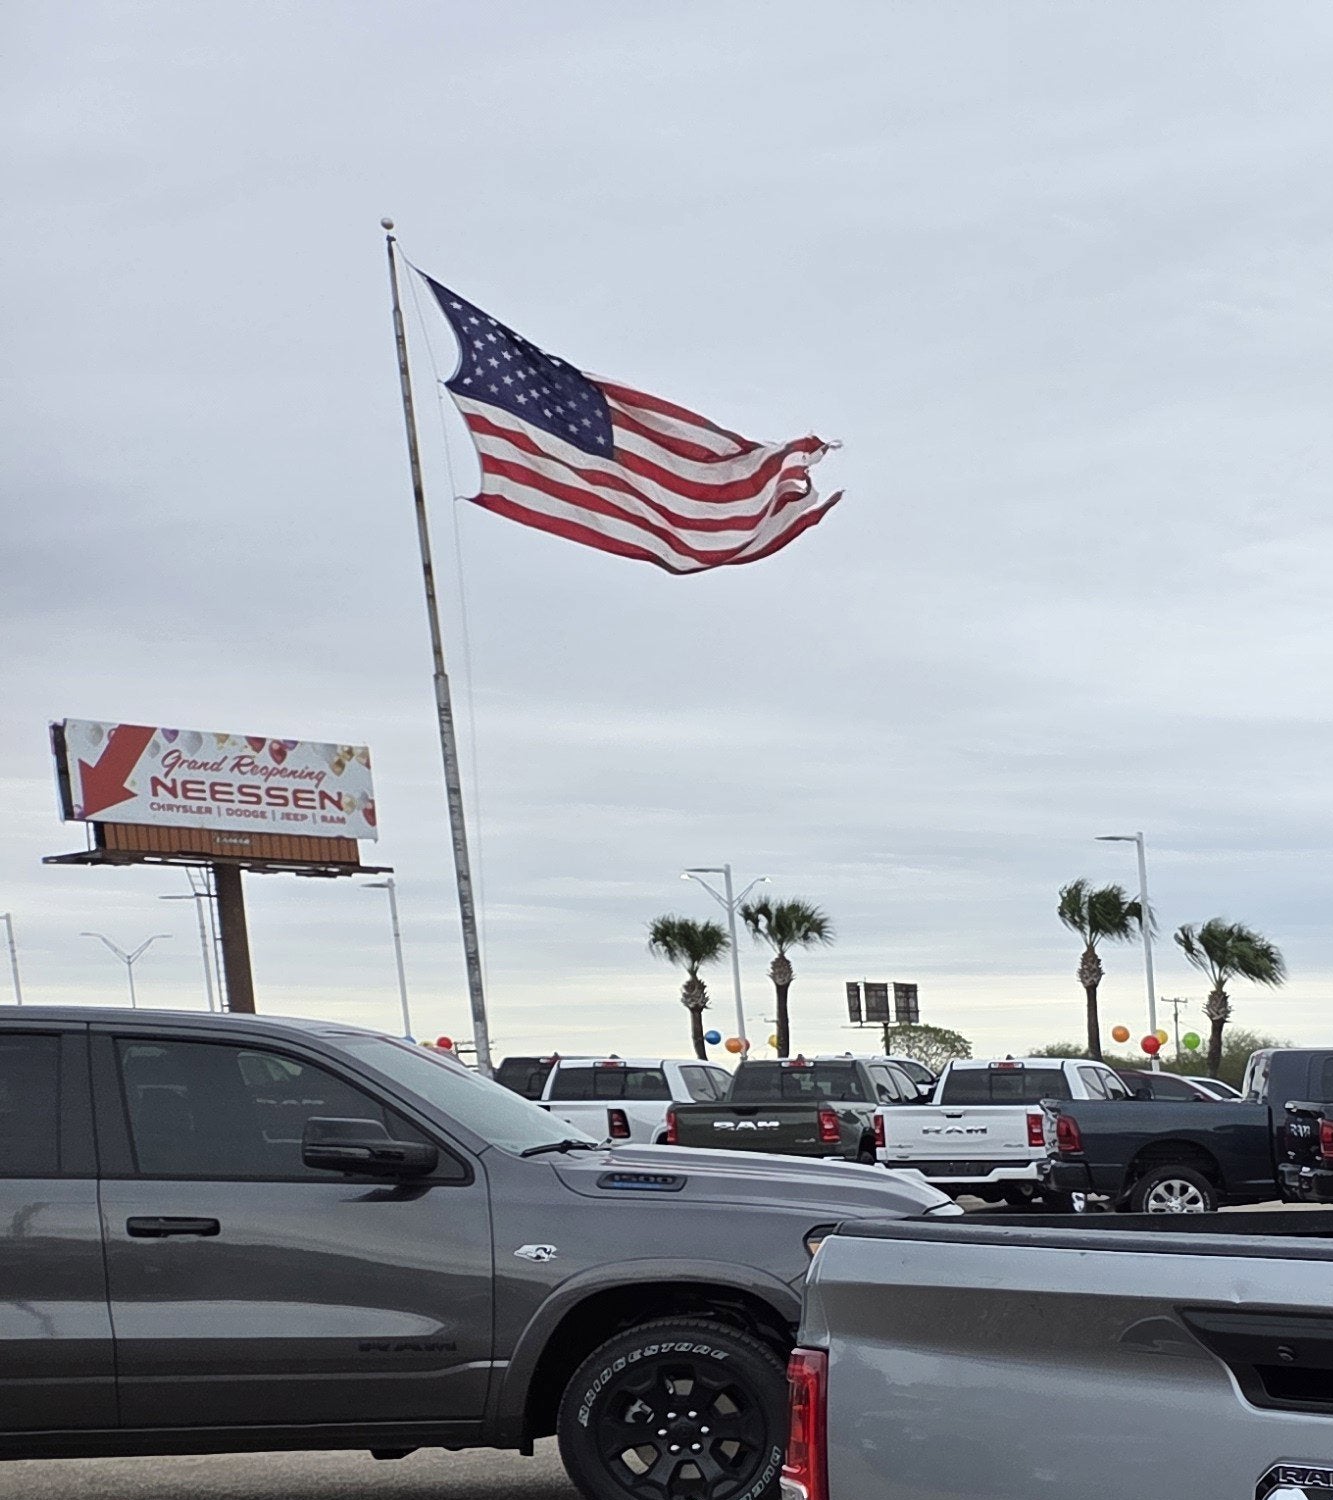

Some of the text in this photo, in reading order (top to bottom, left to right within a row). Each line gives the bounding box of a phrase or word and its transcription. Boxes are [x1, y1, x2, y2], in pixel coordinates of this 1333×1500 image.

[161, 749, 327, 789] Grand Reopening
[150, 775, 345, 812] NEESSEN
[150, 801, 347, 825] CHRYSLER DODGE JEEP RAM
[713, 1121, 780, 1131] RAM
[922, 1125, 988, 1135] RAM
[577, 1341, 731, 1428] BRIDGESTONE
